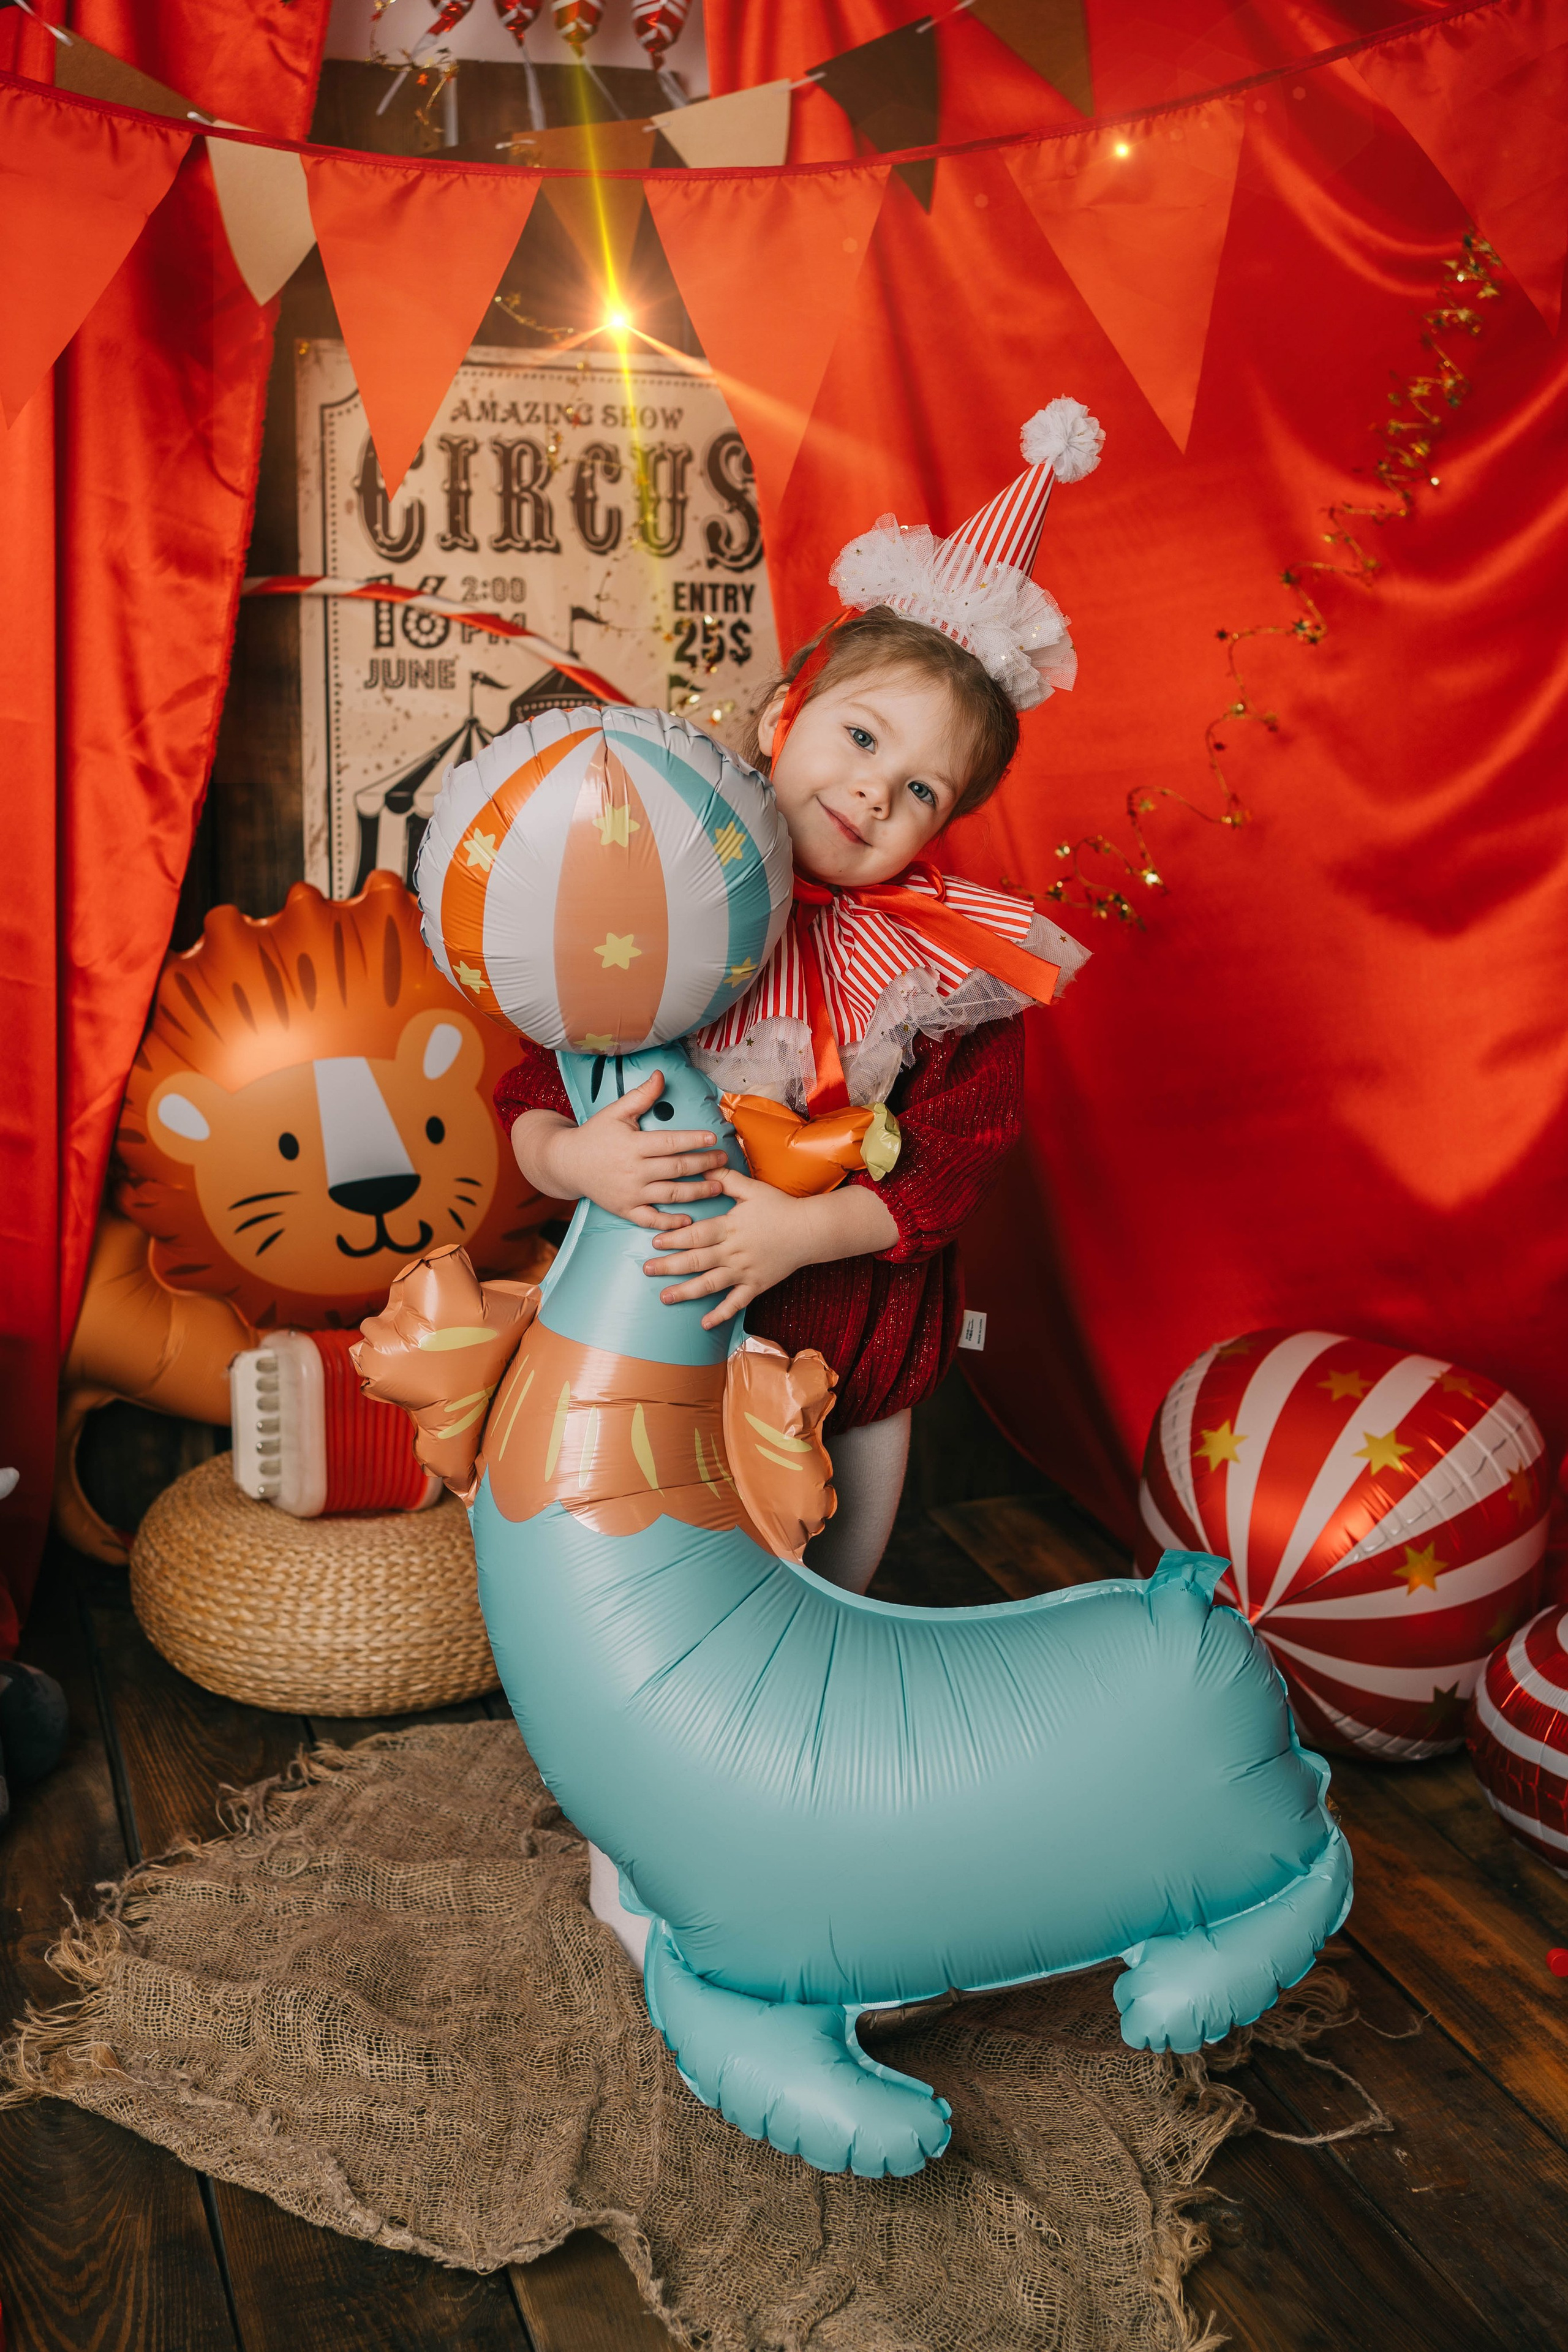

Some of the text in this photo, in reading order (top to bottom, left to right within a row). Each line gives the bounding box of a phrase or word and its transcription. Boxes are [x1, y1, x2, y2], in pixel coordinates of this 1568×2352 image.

[450, 398, 684, 429] AMAZING SHOW
[353, 428, 764, 572] CIRCUS
[461, 576, 527, 603] 2:00
[673, 581, 755, 613] ENTRY
[364, 658, 456, 689] JUNE
